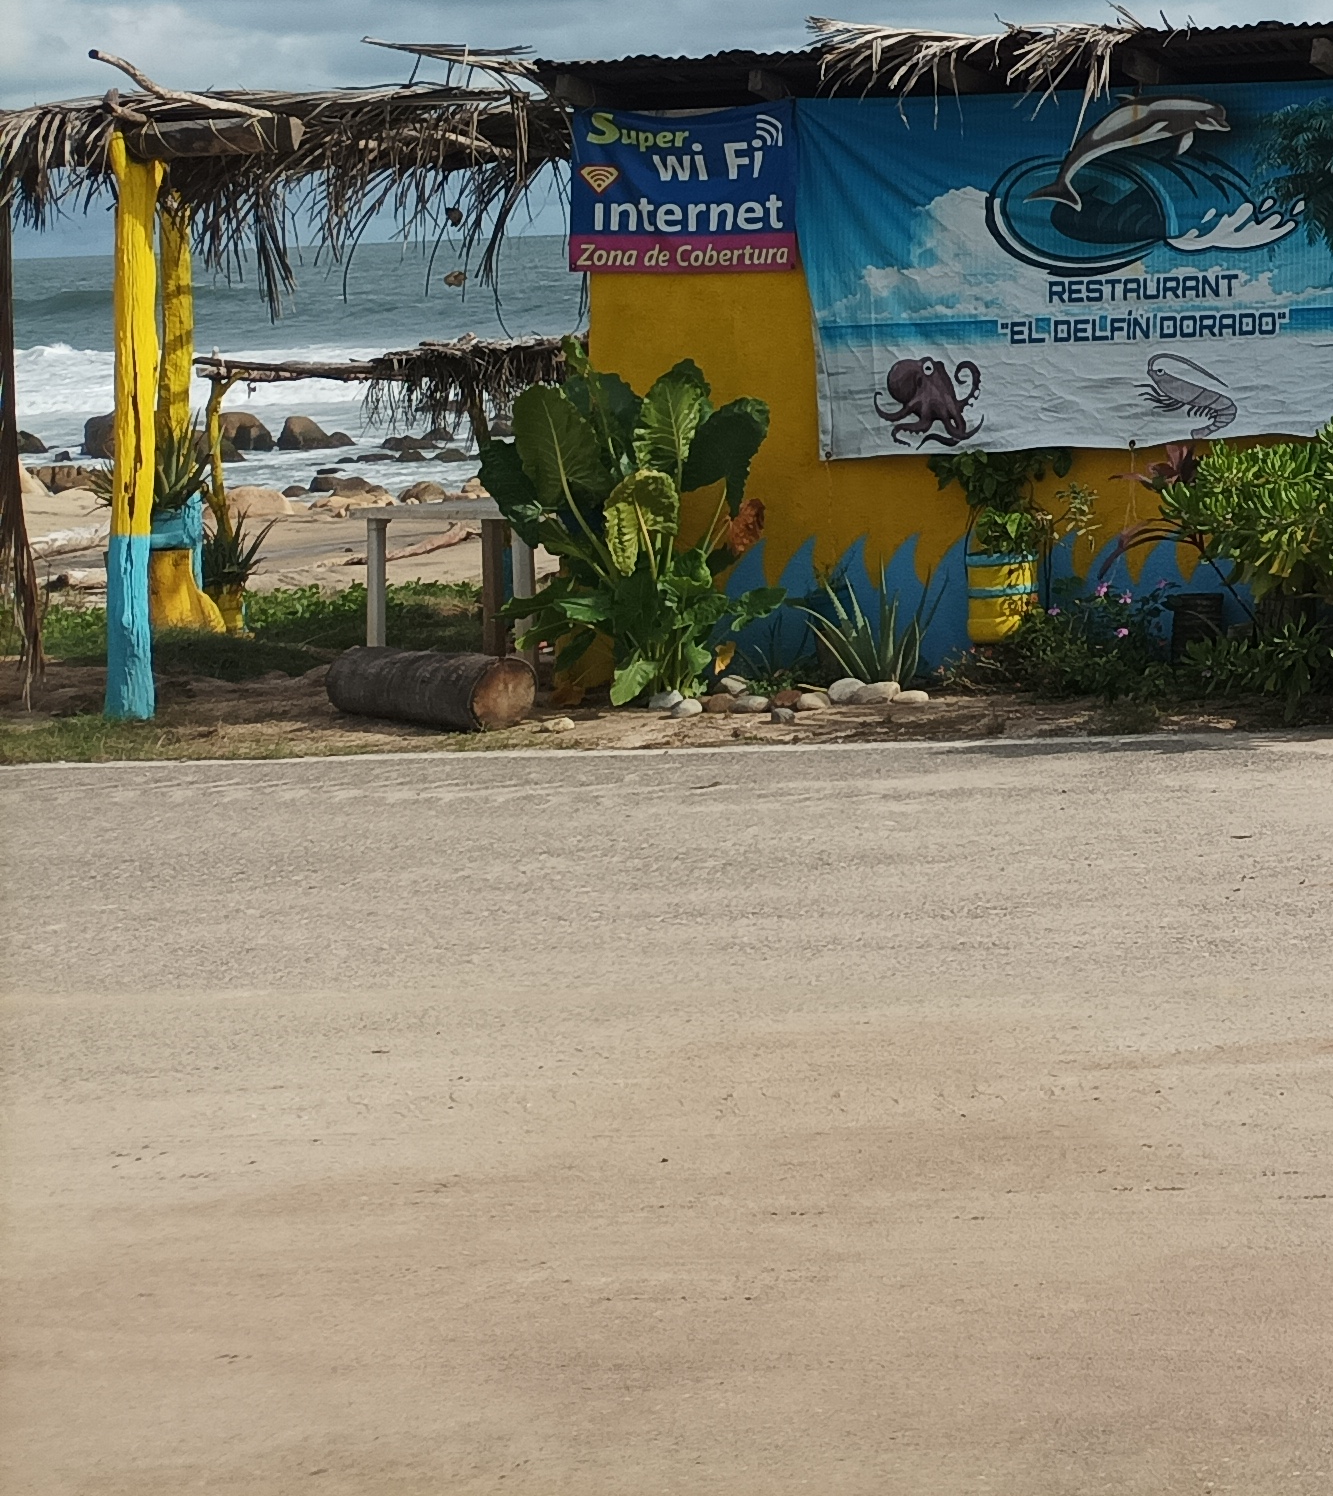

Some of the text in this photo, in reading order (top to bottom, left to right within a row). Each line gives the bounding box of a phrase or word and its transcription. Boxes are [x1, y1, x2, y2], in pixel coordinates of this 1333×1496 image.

[586, 112, 689, 152] Super
[652, 138, 763, 182] wi Fi
[576, 244, 788, 267] Zona de Cobertura
[1048, 274, 1239, 304] RESTAURANT
[1053, 310, 1151, 342] DELFÍN
[1159, 311, 1286, 339] DORADO"
